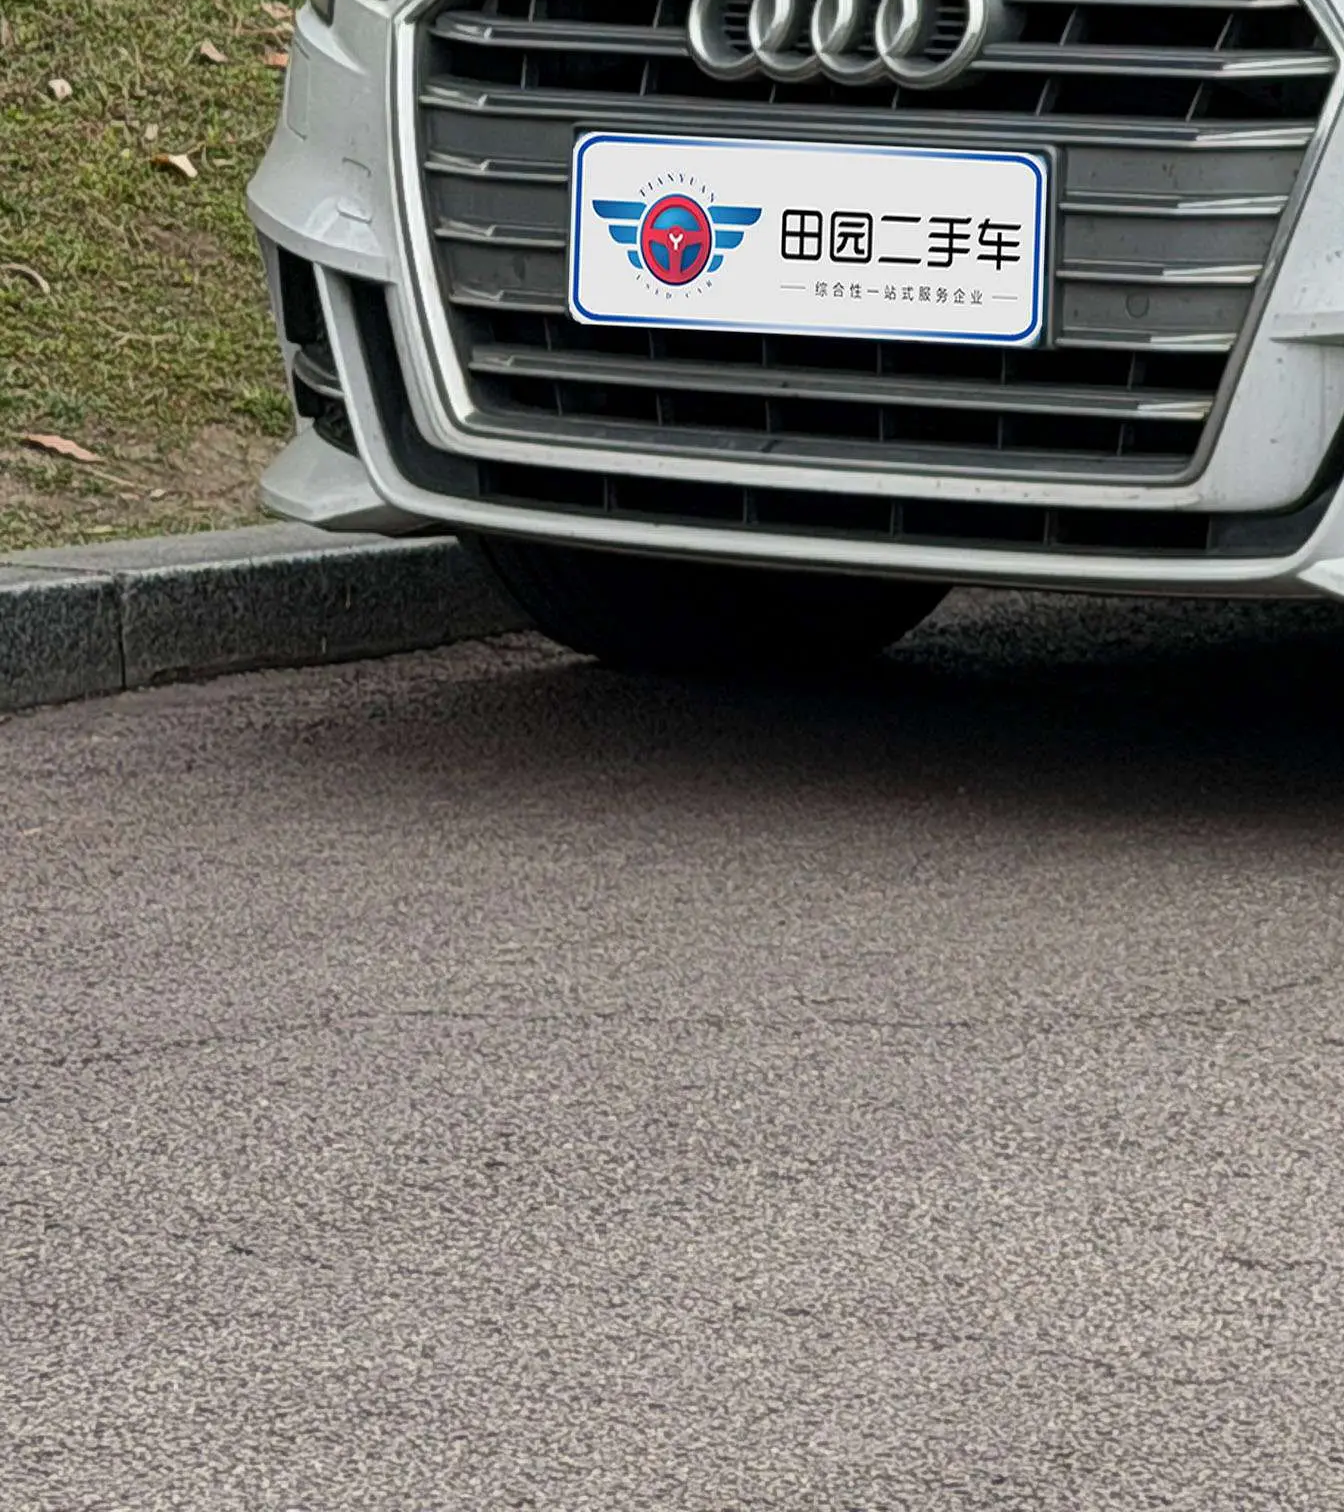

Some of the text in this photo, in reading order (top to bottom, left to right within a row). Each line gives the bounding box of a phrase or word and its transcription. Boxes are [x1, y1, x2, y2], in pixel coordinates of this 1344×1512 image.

[781, 208, 1022, 271] 田园二手车
[814, 281, 984, 305] 综合性一站式服务企业
